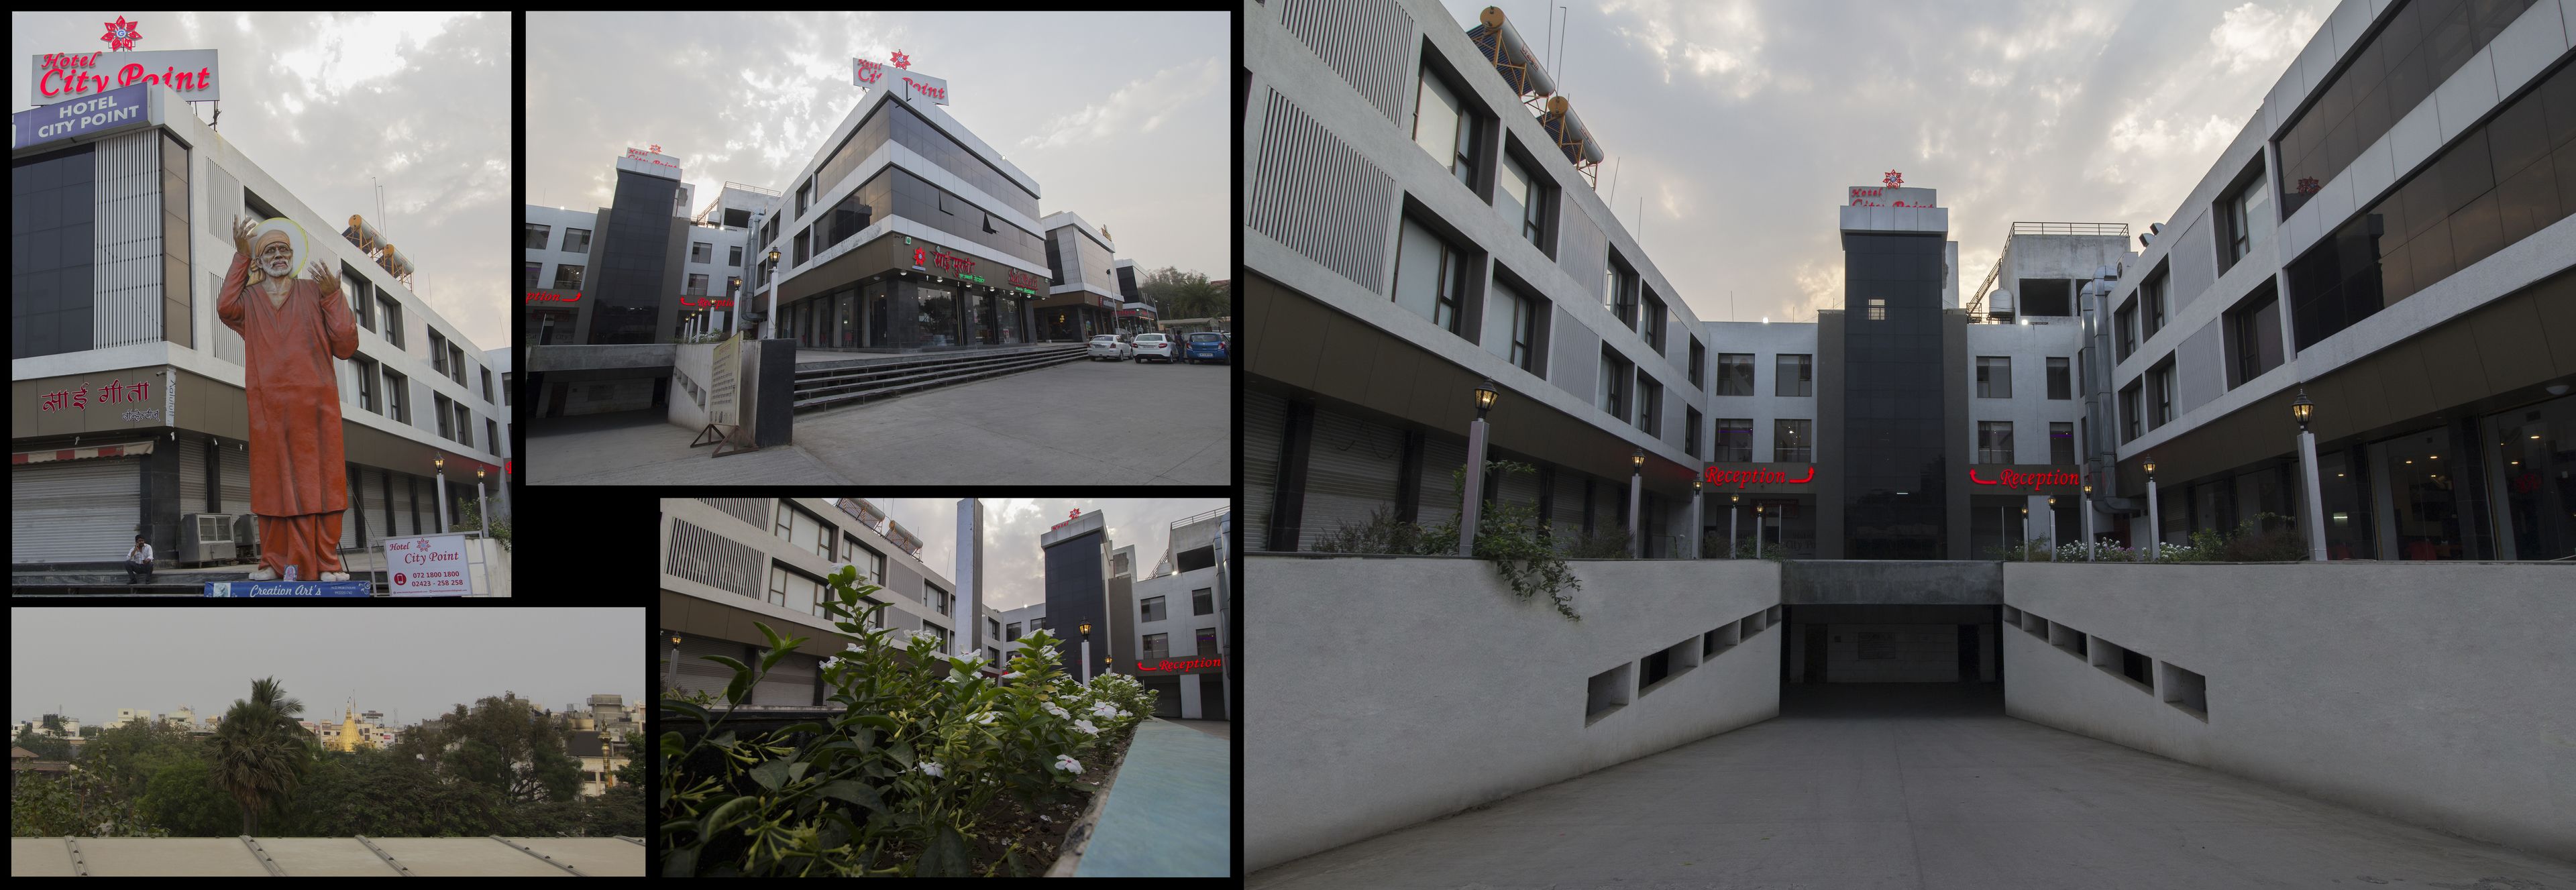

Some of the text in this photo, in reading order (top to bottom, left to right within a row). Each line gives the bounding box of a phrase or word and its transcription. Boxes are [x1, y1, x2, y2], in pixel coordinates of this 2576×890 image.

[41, 51, 103, 68] Hotel
[59, 95, 117, 119] HOTEL
[38, 119, 76, 138] CITY
[80, 105, 140, 129] POINT
[1851, 187, 1883, 198] Hotel
[42, 378, 150, 413] साई गीता
[1705, 466, 1786, 489] Reception
[2000, 468, 2080, 491] Reception
[390, 542, 411, 551] Hotel
[405, 551, 459, 565] City Point
[250, 584, 321, 597] Creation Art's
[1159, 657, 1221, 673] Reception
